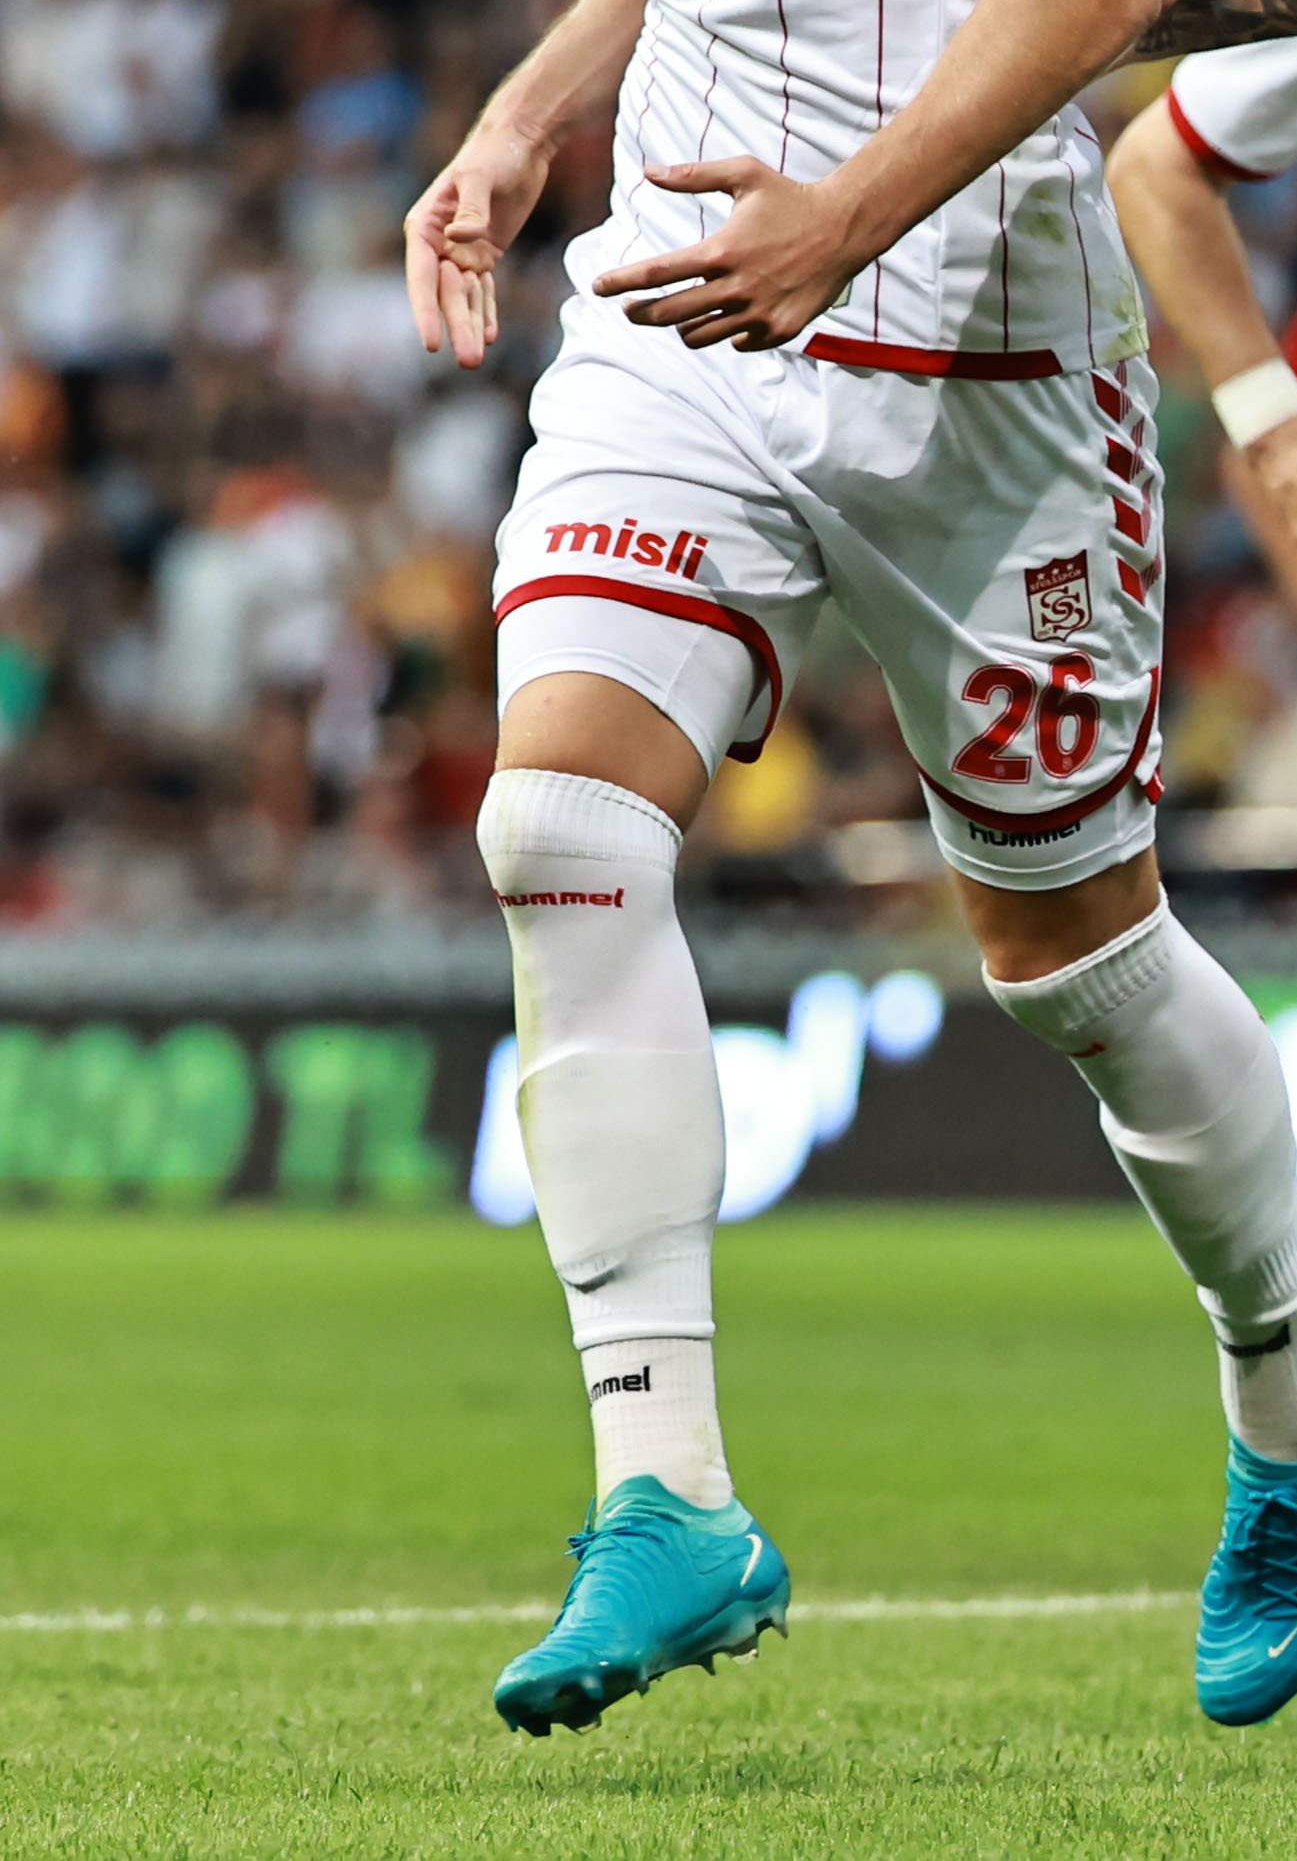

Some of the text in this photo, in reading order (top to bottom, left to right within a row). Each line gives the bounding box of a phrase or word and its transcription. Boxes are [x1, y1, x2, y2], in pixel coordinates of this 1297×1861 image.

[544, 517, 709, 581] misli
[951, 650, 1100, 785] 26
[493, 887, 625, 909] hummel
